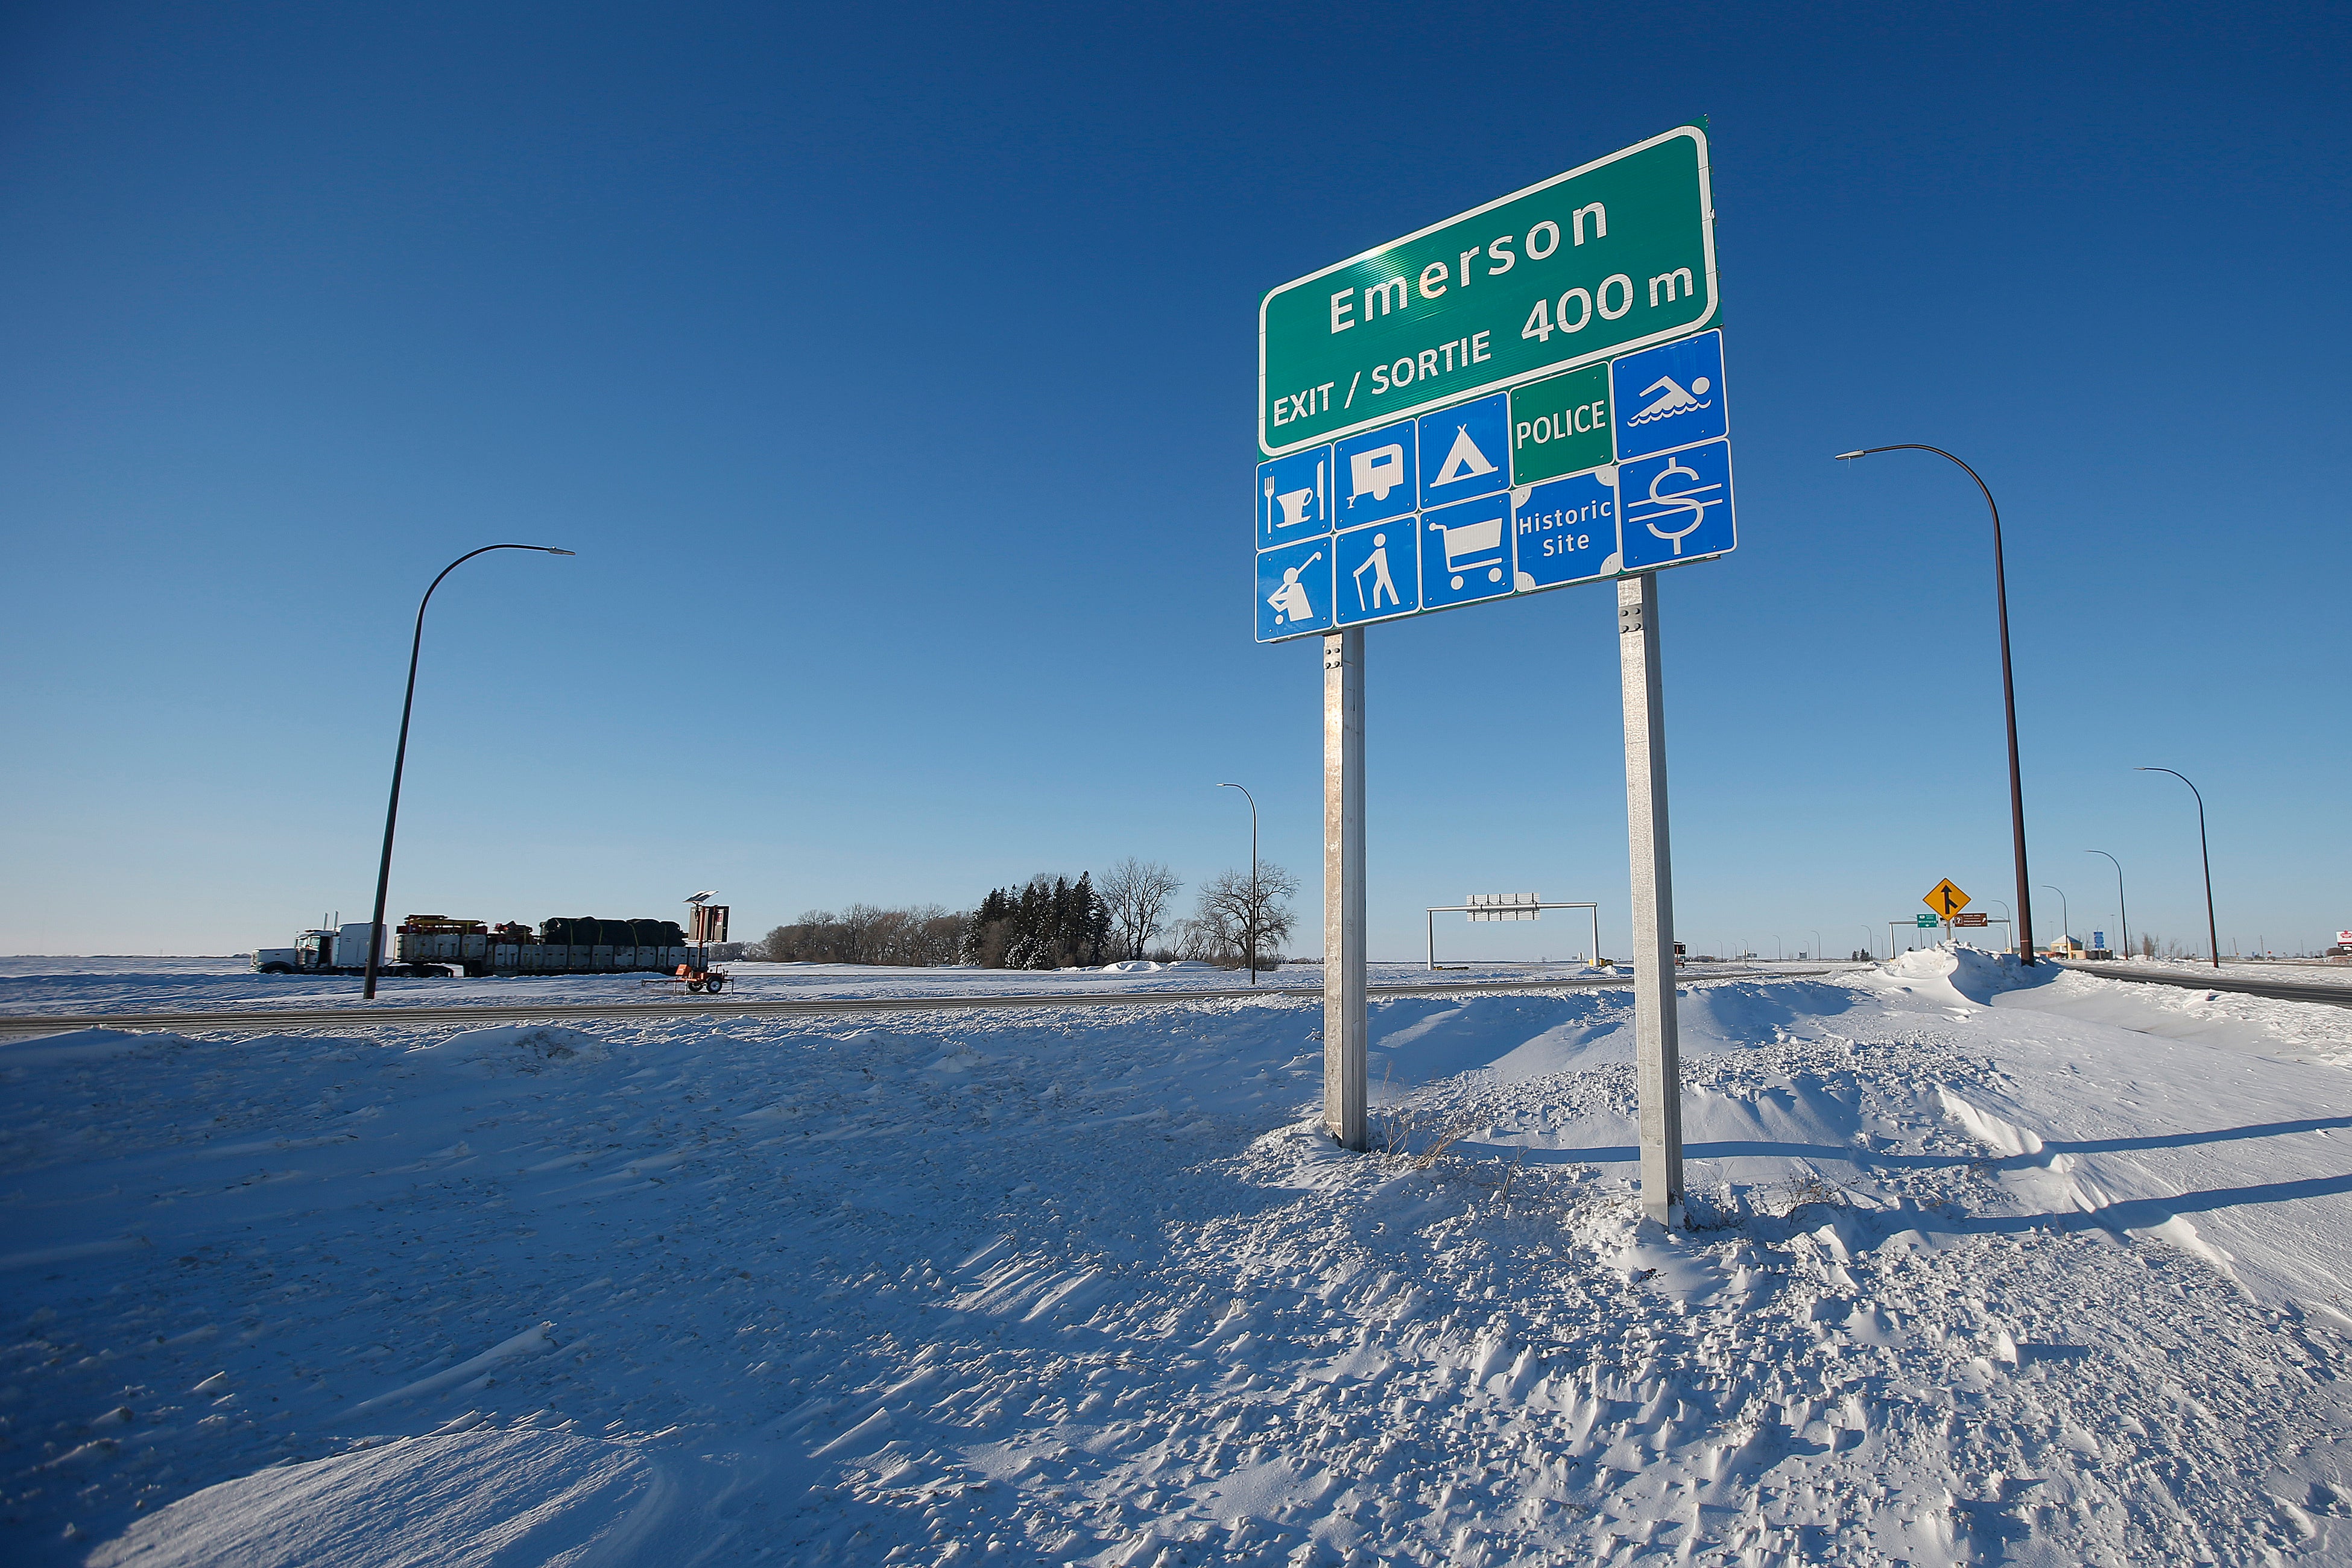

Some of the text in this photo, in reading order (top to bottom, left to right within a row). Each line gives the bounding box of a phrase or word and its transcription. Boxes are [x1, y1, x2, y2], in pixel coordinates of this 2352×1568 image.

[1330, 201, 1607, 335] Emerson
[1273, 267, 1694, 428] EXIT / SORTIE 400 m
[1516, 399, 1607, 450] POLICE
[1519, 499, 1612, 536] Historic
[1543, 533, 1590, 557] Site
